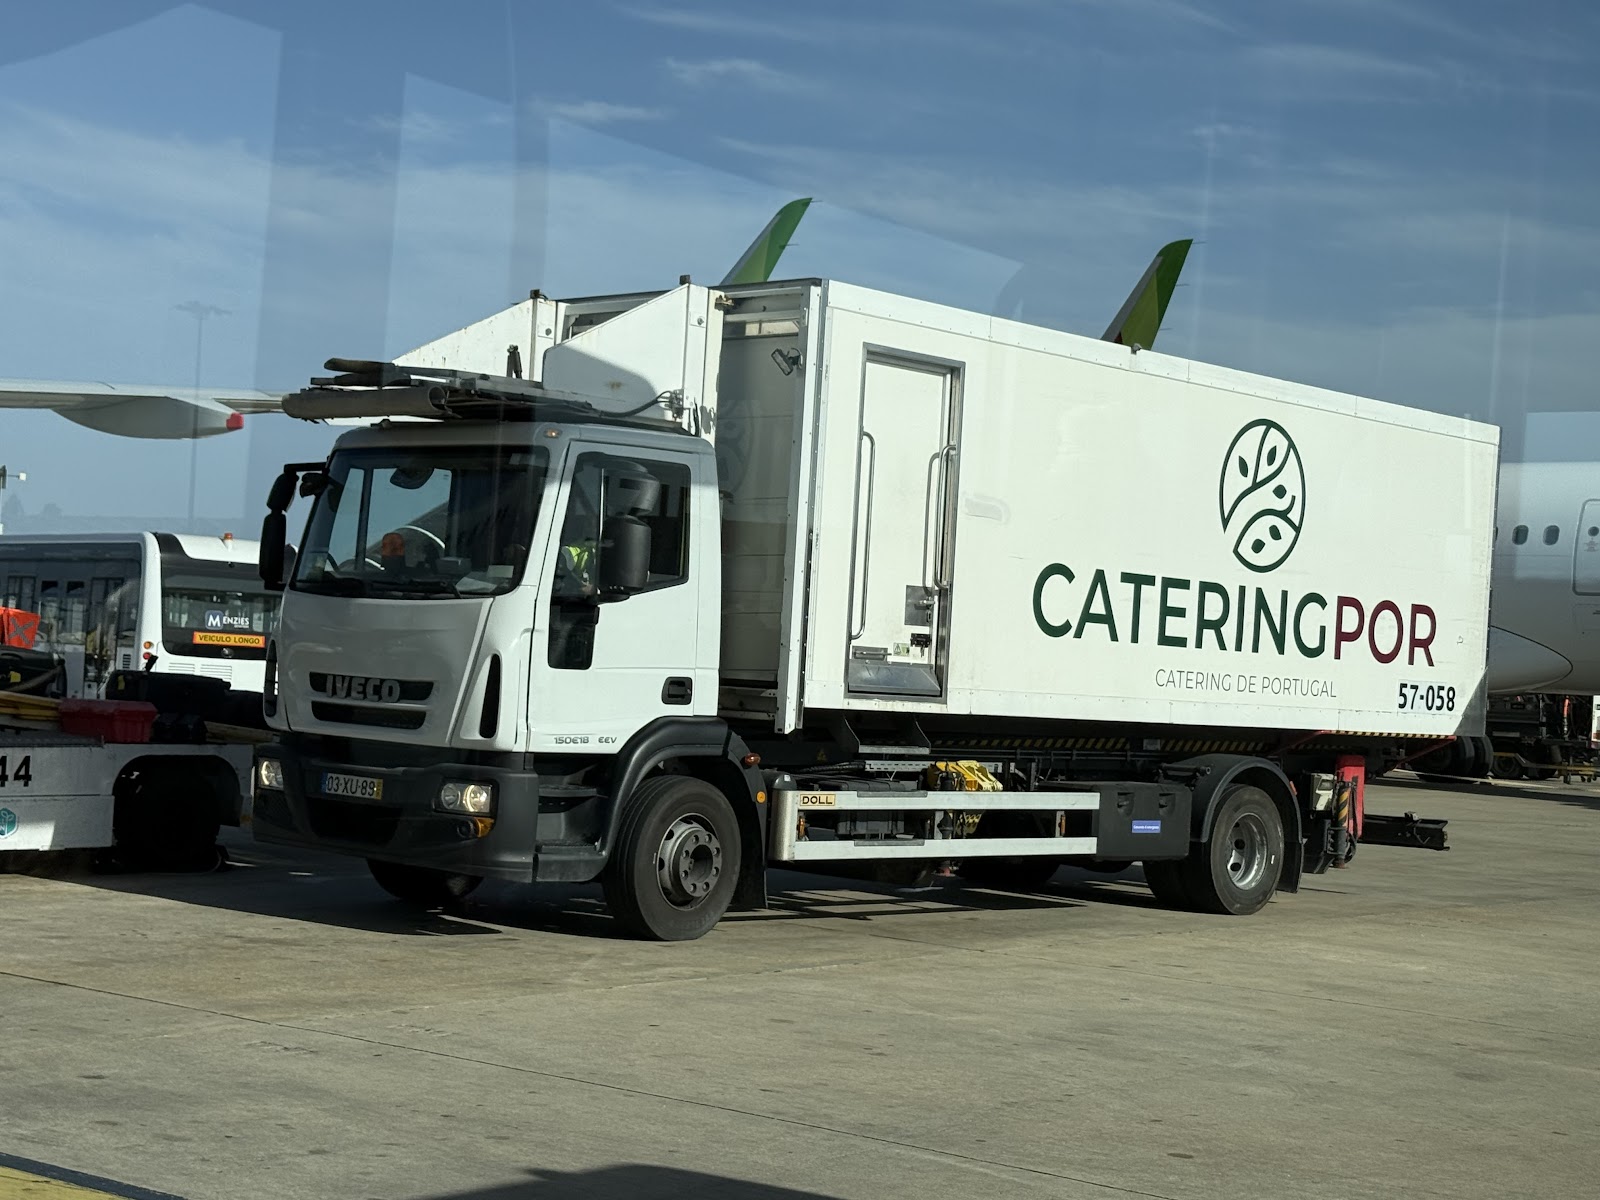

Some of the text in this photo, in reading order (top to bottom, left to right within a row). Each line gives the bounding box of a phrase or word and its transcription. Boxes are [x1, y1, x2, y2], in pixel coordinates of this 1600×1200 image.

[207, 614, 250, 627] MENZIES
[1032, 562, 1437, 667] CATERINGPOR
[199, 634, 260, 645] VEICULO LONGO
[326, 674, 400, 703] IVECO
[1155, 668, 1337, 698] CATERING DE PORTUGAL
[1398, 682, 1456, 712] 57-058
[553, 736, 618, 744] 150E18 EEV
[802, 795, 833, 804] DOLL
